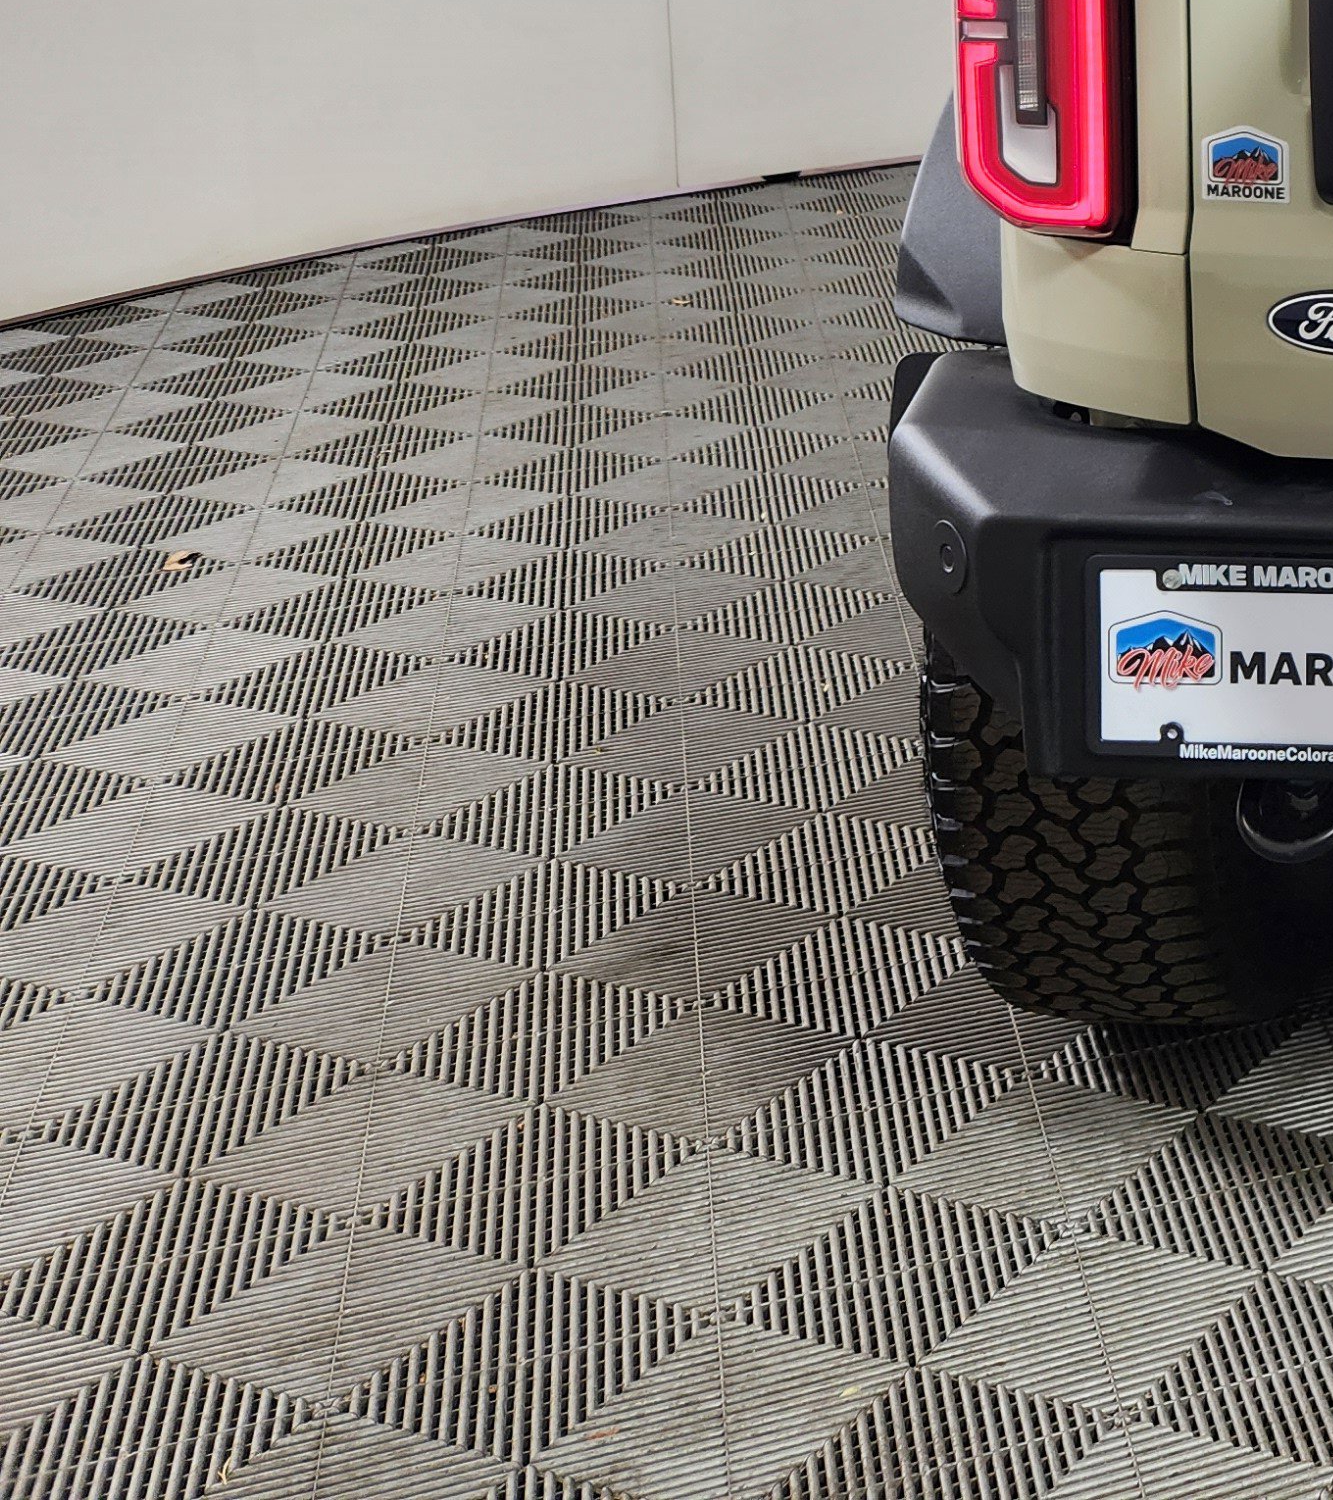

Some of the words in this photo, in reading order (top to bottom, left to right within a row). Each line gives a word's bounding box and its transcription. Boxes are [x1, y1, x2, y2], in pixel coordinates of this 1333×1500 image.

[1207, 184, 1285, 199] MAROONE
[1178, 563, 1247, 587] MIKE
[1116, 644, 1215, 692] Mike
